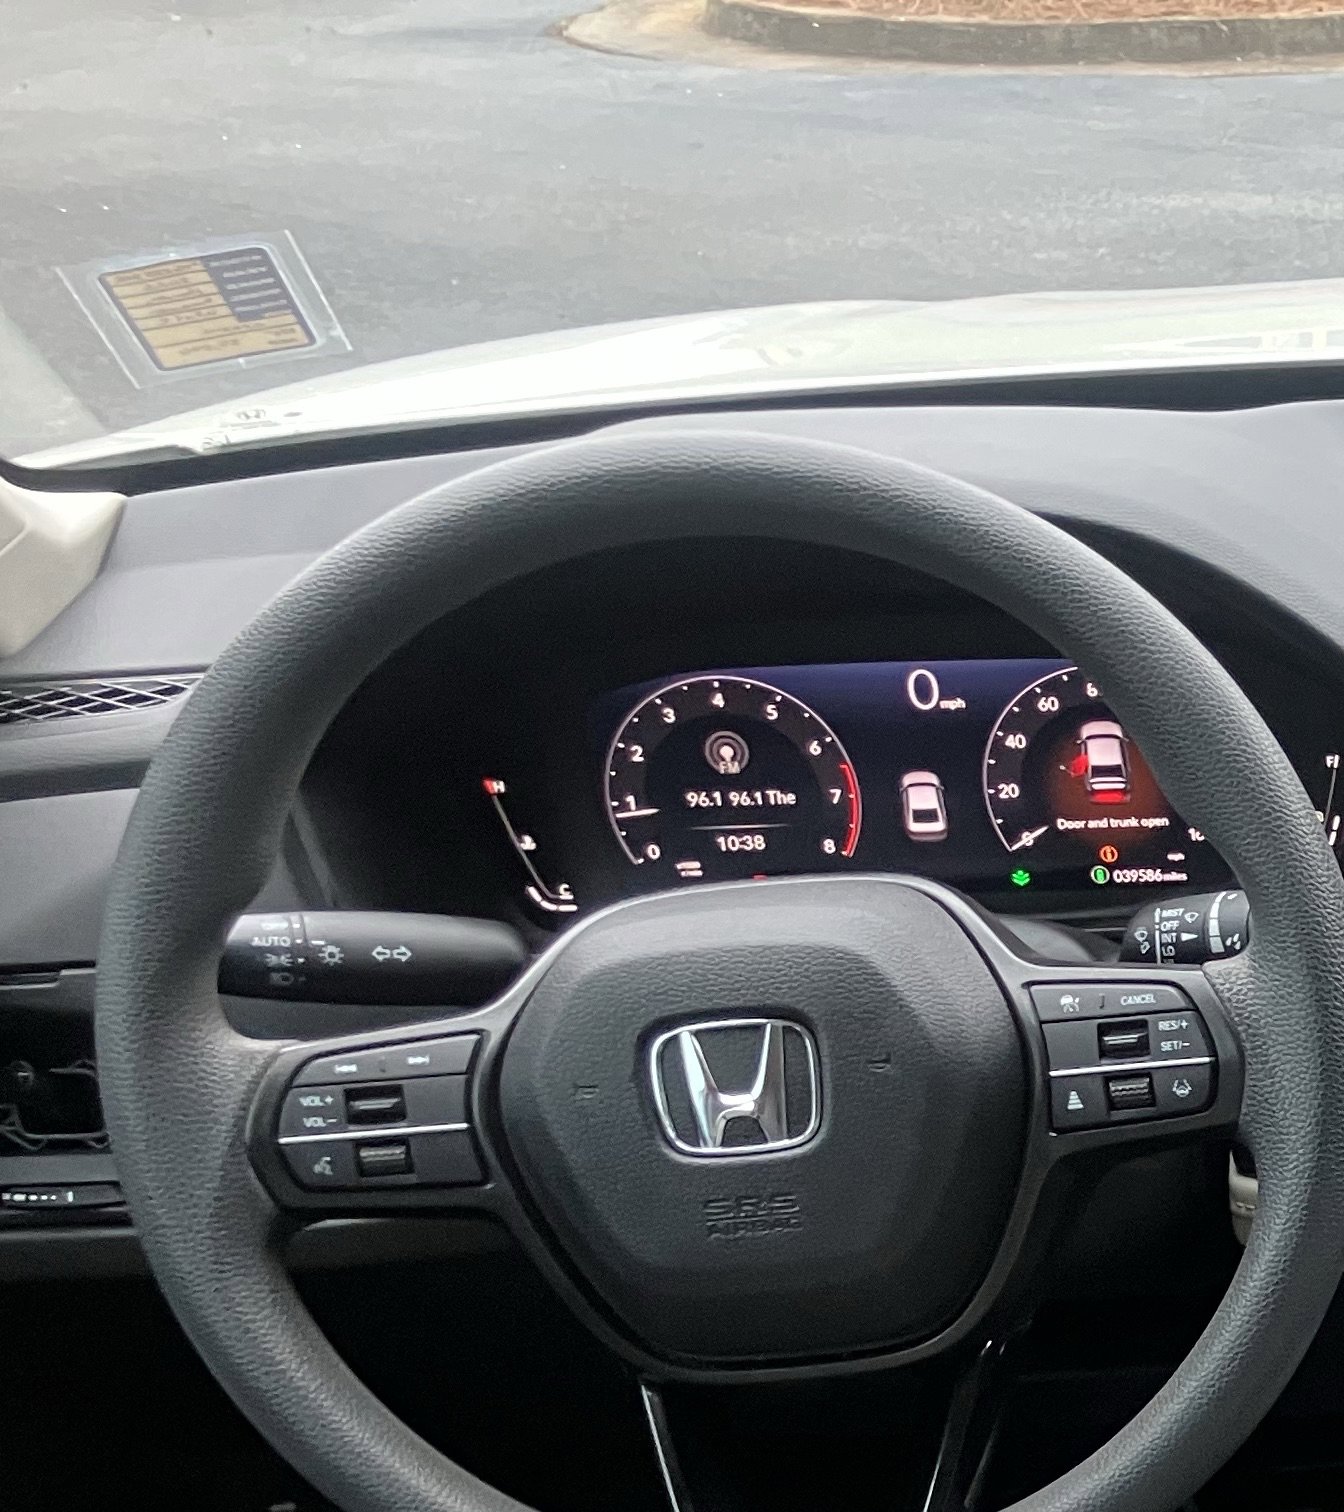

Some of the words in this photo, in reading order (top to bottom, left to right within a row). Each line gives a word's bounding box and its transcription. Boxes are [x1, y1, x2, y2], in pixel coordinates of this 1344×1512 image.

[907, 668, 940, 711] 0
[939, 698, 967, 710] mph
[711, 692, 725, 709] 4
[1037, 696, 1060, 712] 60
[662, 707, 677, 724] 3
[766, 704, 779, 721] 5
[809, 741, 822, 756] 6
[1004, 734, 1027, 750] 40
[632, 745, 645, 762] 2
[686, 791, 722, 807] 96.1
[729, 790, 763, 806] 96.1
[766, 790, 797, 805] The
[829, 788, 842, 804] 7
[998, 783, 1020, 800] 20
[626, 795, 637, 811] 1
[1056, 818, 1087, 831] Door
[1087, 818, 1109, 830] and
[1109, 817, 1141, 829] trunk
[1140, 817, 1170, 830] open
[717, 835, 766, 852] 10:38
[823, 839, 837, 855] 8
[647, 845, 660, 860] 0
[1112, 868, 1163, 884] 039586
[1160, 920, 1180, 932] OFF
[250, 935, 291, 947] AUTO
[1120, 994, 1157, 1006] CANCEL
